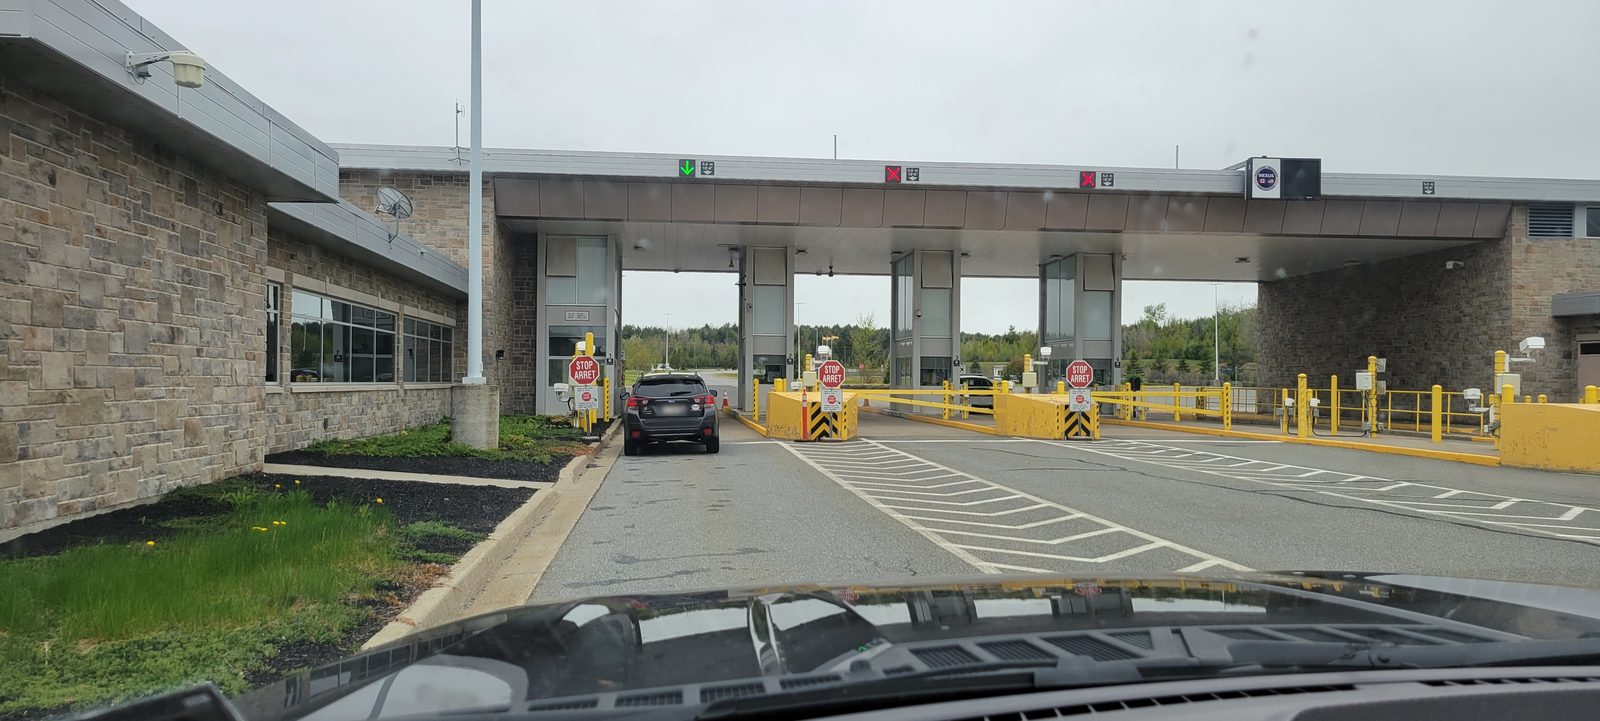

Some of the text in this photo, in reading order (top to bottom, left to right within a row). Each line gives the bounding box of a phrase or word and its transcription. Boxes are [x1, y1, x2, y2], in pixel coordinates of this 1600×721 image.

[576, 360, 594, 370] STOP
[824, 366, 840, 374] STOP
[1072, 366, 1088, 374] STOP
[574, 370, 596, 380] ARRET
[822, 374, 842, 382] ARRET
[1070, 374, 1090, 383] ARRET
